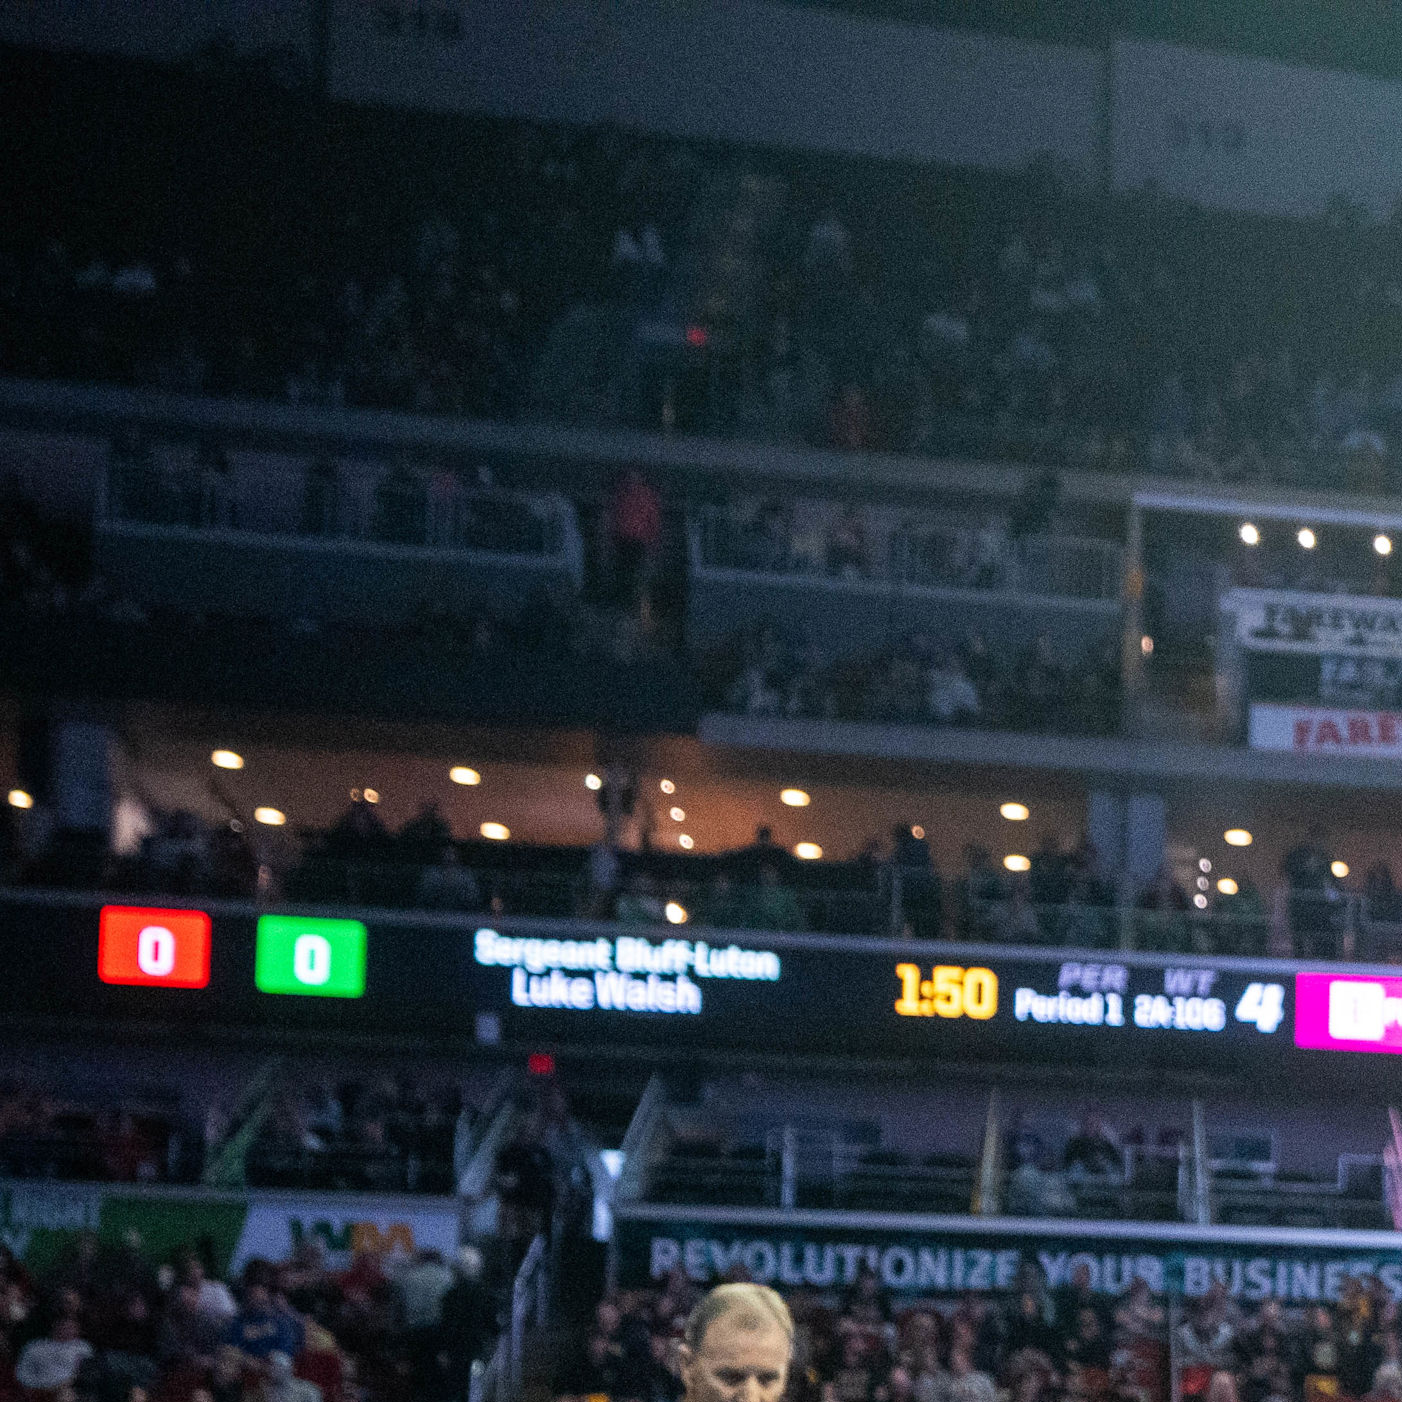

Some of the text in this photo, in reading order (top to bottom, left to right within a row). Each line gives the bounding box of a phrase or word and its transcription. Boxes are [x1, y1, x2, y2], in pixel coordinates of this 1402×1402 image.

[138, 925, 175, 977] 0
[294, 934, 331, 985] 0
[476, 930, 779, 978] Sergeant Bluff-Luton
[513, 968, 701, 1011] Luke Walsh
[895, 962, 999, 1020] 1:50
[1058, 962, 1219, 996] PER WT
[1016, 988, 1103, 1022] Period
[1107, 992, 1122, 1024] 1
[1237, 984, 1283, 1031] 4
